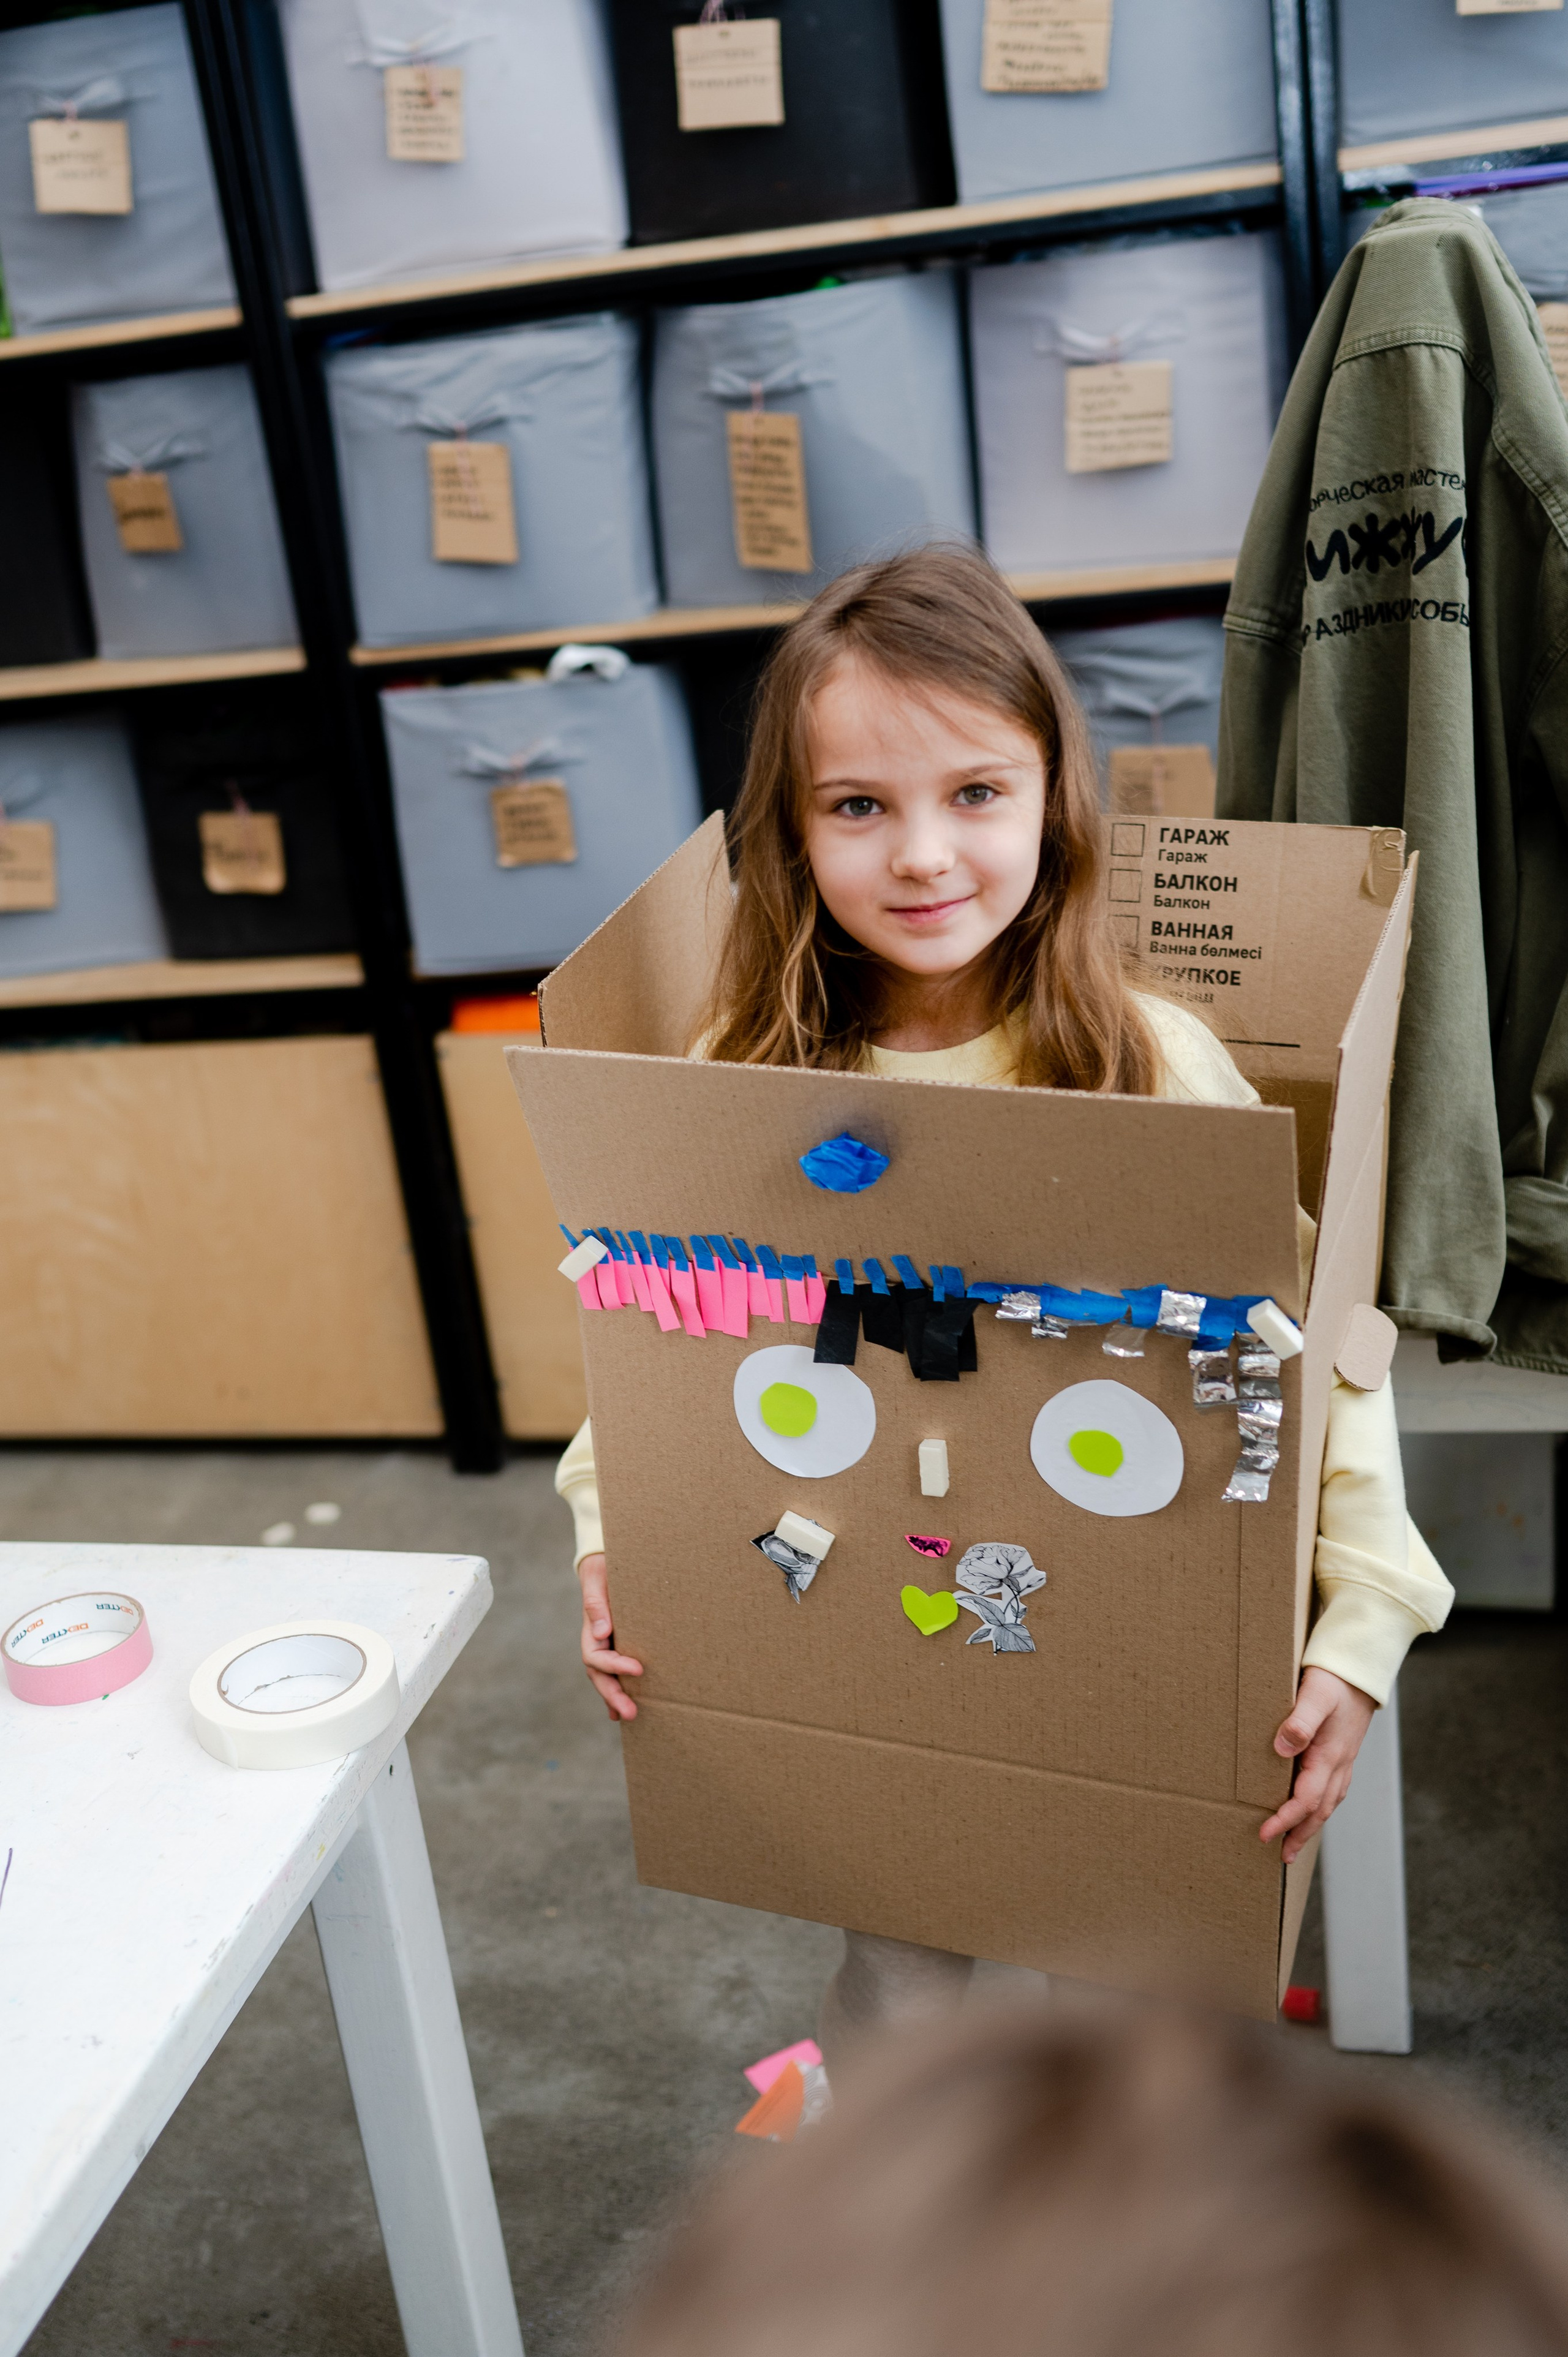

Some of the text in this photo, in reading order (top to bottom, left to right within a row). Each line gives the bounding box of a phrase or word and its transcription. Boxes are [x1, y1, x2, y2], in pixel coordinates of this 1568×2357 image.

[1159, 828, 1230, 846] ГАРАЖ
[1158, 849, 1208, 865] Гараж
[1154, 873, 1238, 892] БАЛКОН
[1153, 894, 1211, 910] Балкон
[1151, 921, 1234, 940] ВАННАЯ
[1149, 941, 1262, 960] Ванна бөлмесі
[1149, 964, 1242, 986] РУПКОЕ
[96, 1603, 134, 1616] DEXTER
[11, 1618, 44, 1648] DEXTER
[41, 1622, 89, 1645] DEXTER
